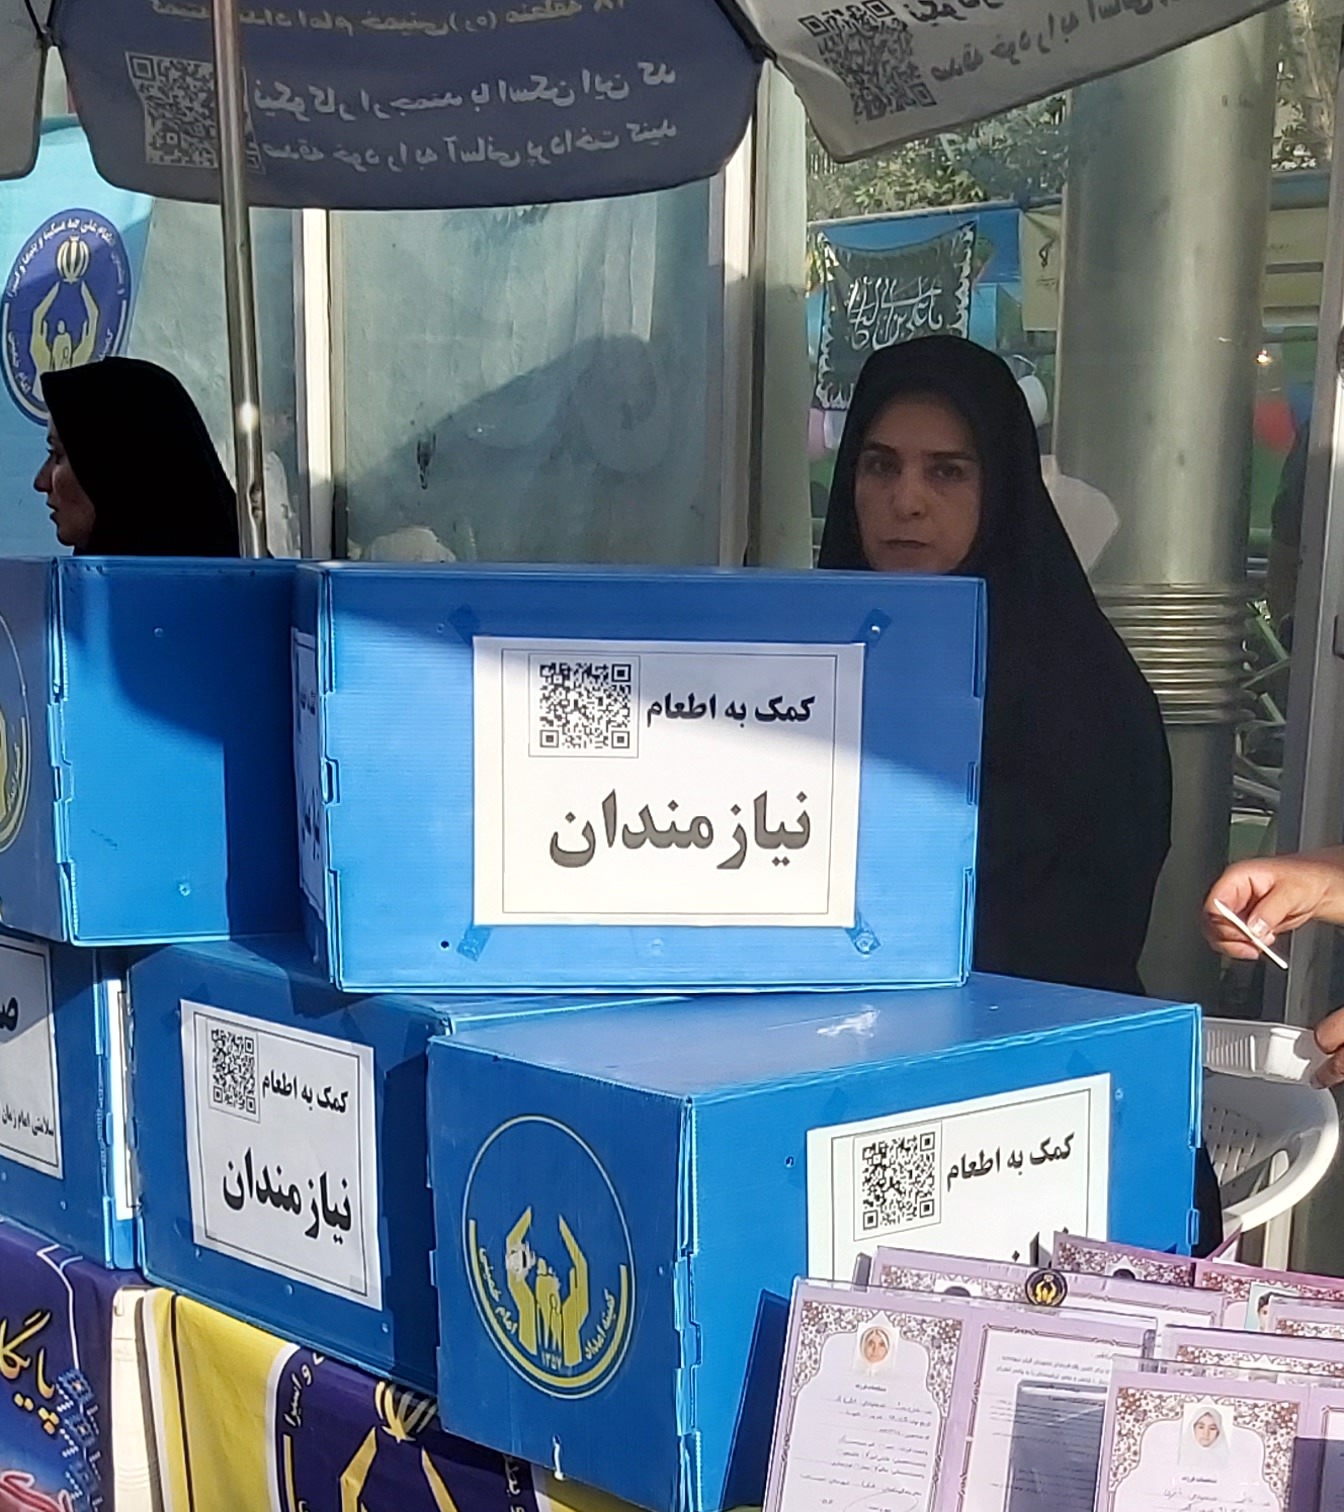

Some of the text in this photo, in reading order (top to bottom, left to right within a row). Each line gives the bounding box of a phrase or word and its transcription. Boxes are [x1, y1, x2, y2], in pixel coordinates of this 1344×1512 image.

[646, 692, 816, 729] کمک به اطعام
[549, 788, 811, 870] نیازمندان
[261, 1069, 348, 1114] کمک به اطعام
[946, 1131, 1075, 1192] کمک به اطعام
[222, 1147, 352, 1245] نیازمندان
